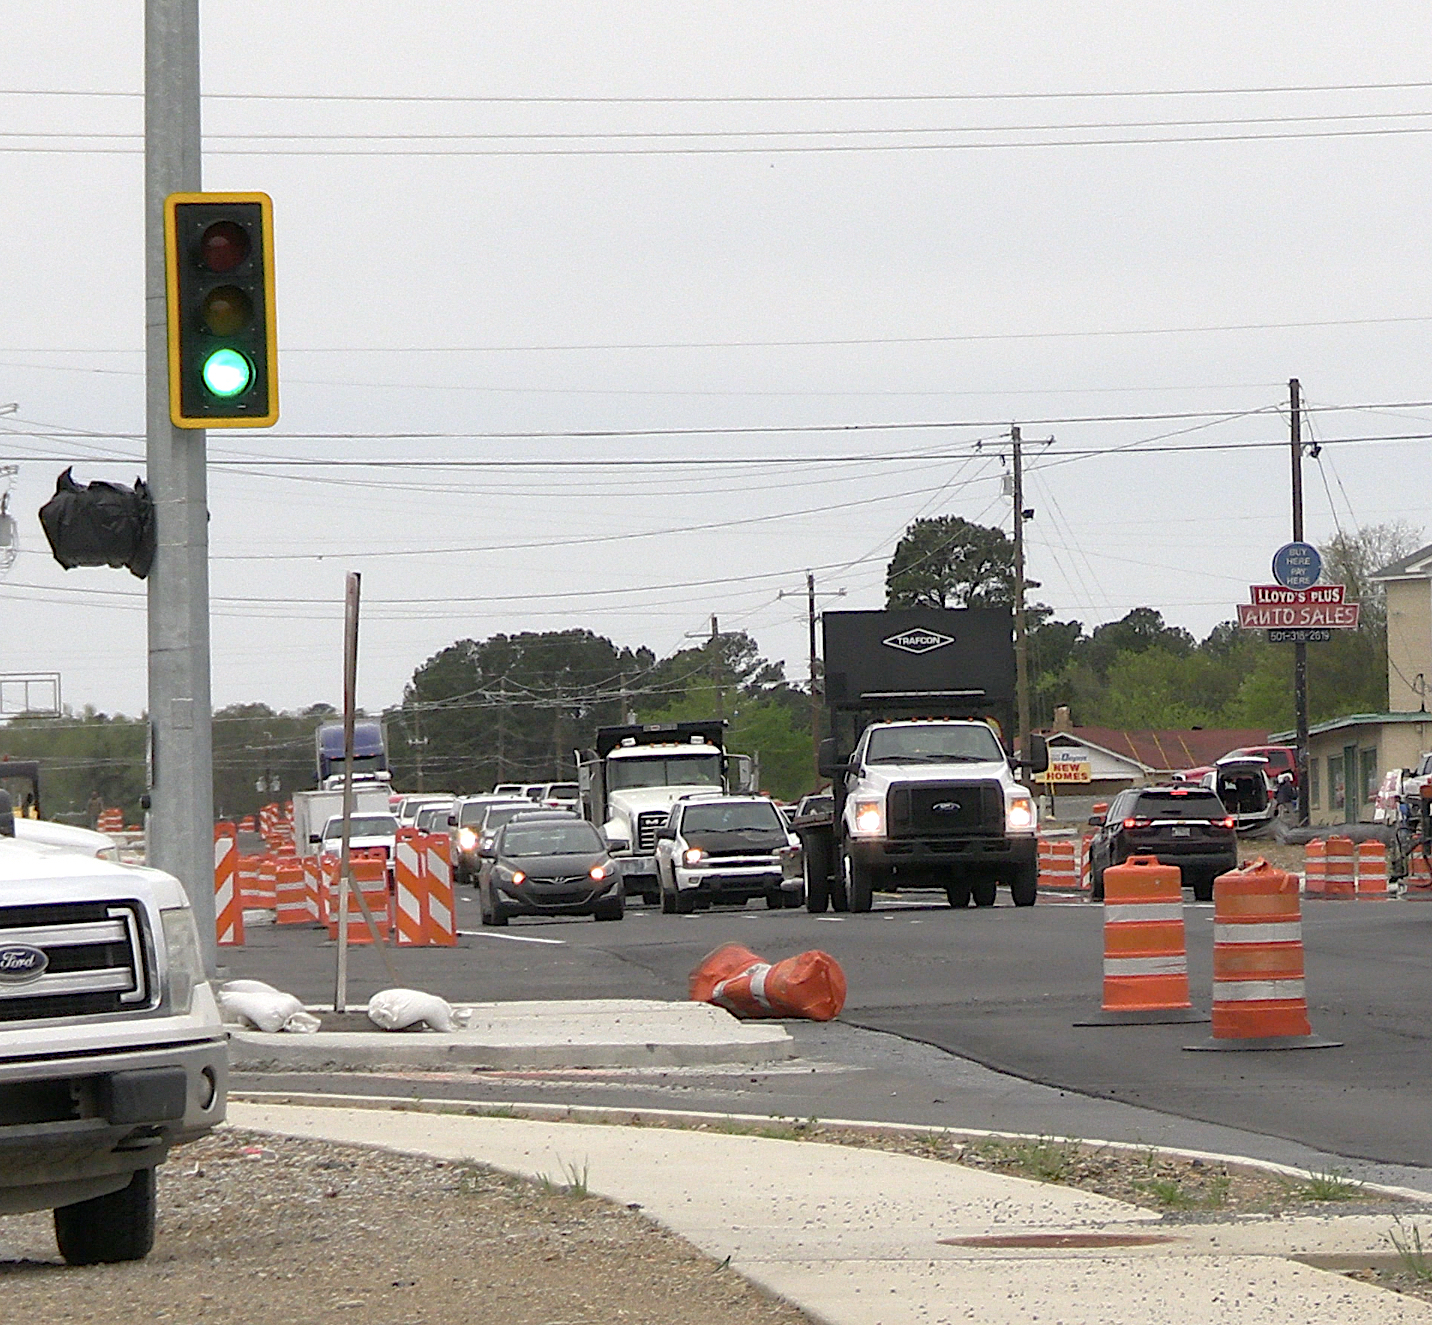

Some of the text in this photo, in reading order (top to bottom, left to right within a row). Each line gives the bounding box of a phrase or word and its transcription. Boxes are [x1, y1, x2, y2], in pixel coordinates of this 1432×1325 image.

[1286, 557, 1310, 565] HERE
[1291, 568, 1306, 576] PAY
[1286, 577, 1310, 585] HERE
[1258, 588, 1340, 603] LLOYD'S PLUS
[1244, 607, 1354, 625] AUTO SALES
[897, 636, 940, 645] TRAFCON
[1046, 772, 1088, 780] HOMES
[0, 951, 36, 968] Ford
